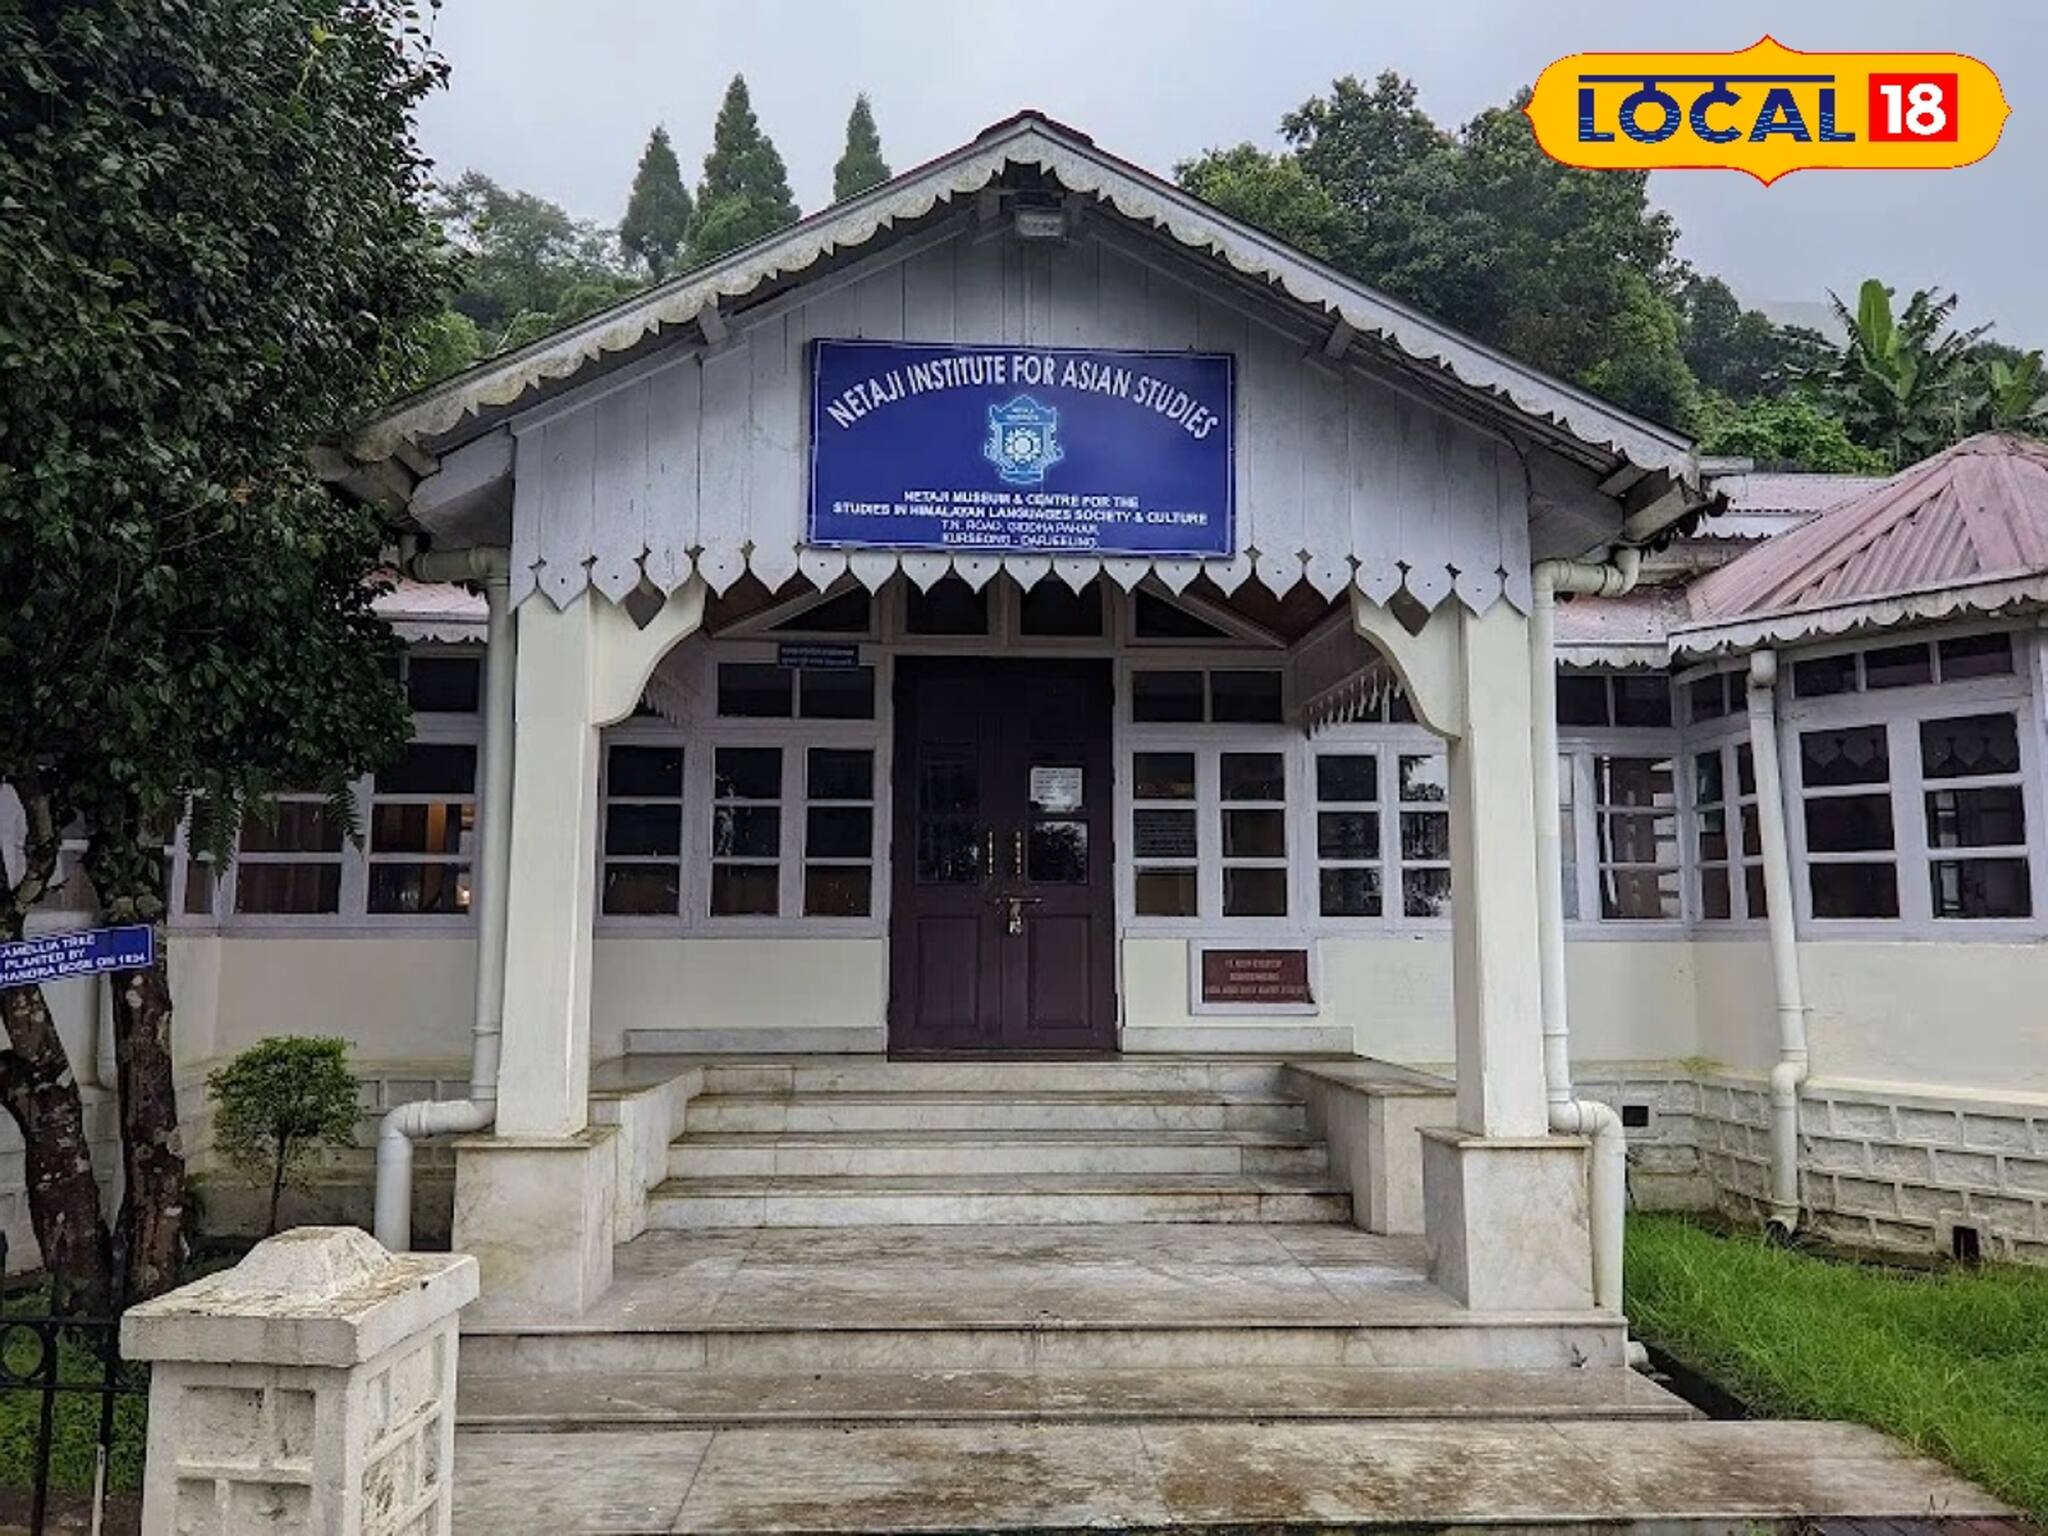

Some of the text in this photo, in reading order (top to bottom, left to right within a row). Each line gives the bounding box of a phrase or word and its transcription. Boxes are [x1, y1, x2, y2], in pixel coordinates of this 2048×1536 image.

[826, 355, 1219, 439] NETAJI INSTITUTE FOR ASIAN STUDIES
[904, 490, 1139, 509] NETAJI MUSEUM & CENTRE FOR THE
[833, 501, 1208, 526] STUDIES IN HIMALAYAN LANGUAGES SOCIETY & CULTURE
[0, 940, 61, 958] AMELLIA
[68, 947, 87, 960] BY
[0, 964, 56, 983] HANDRA
